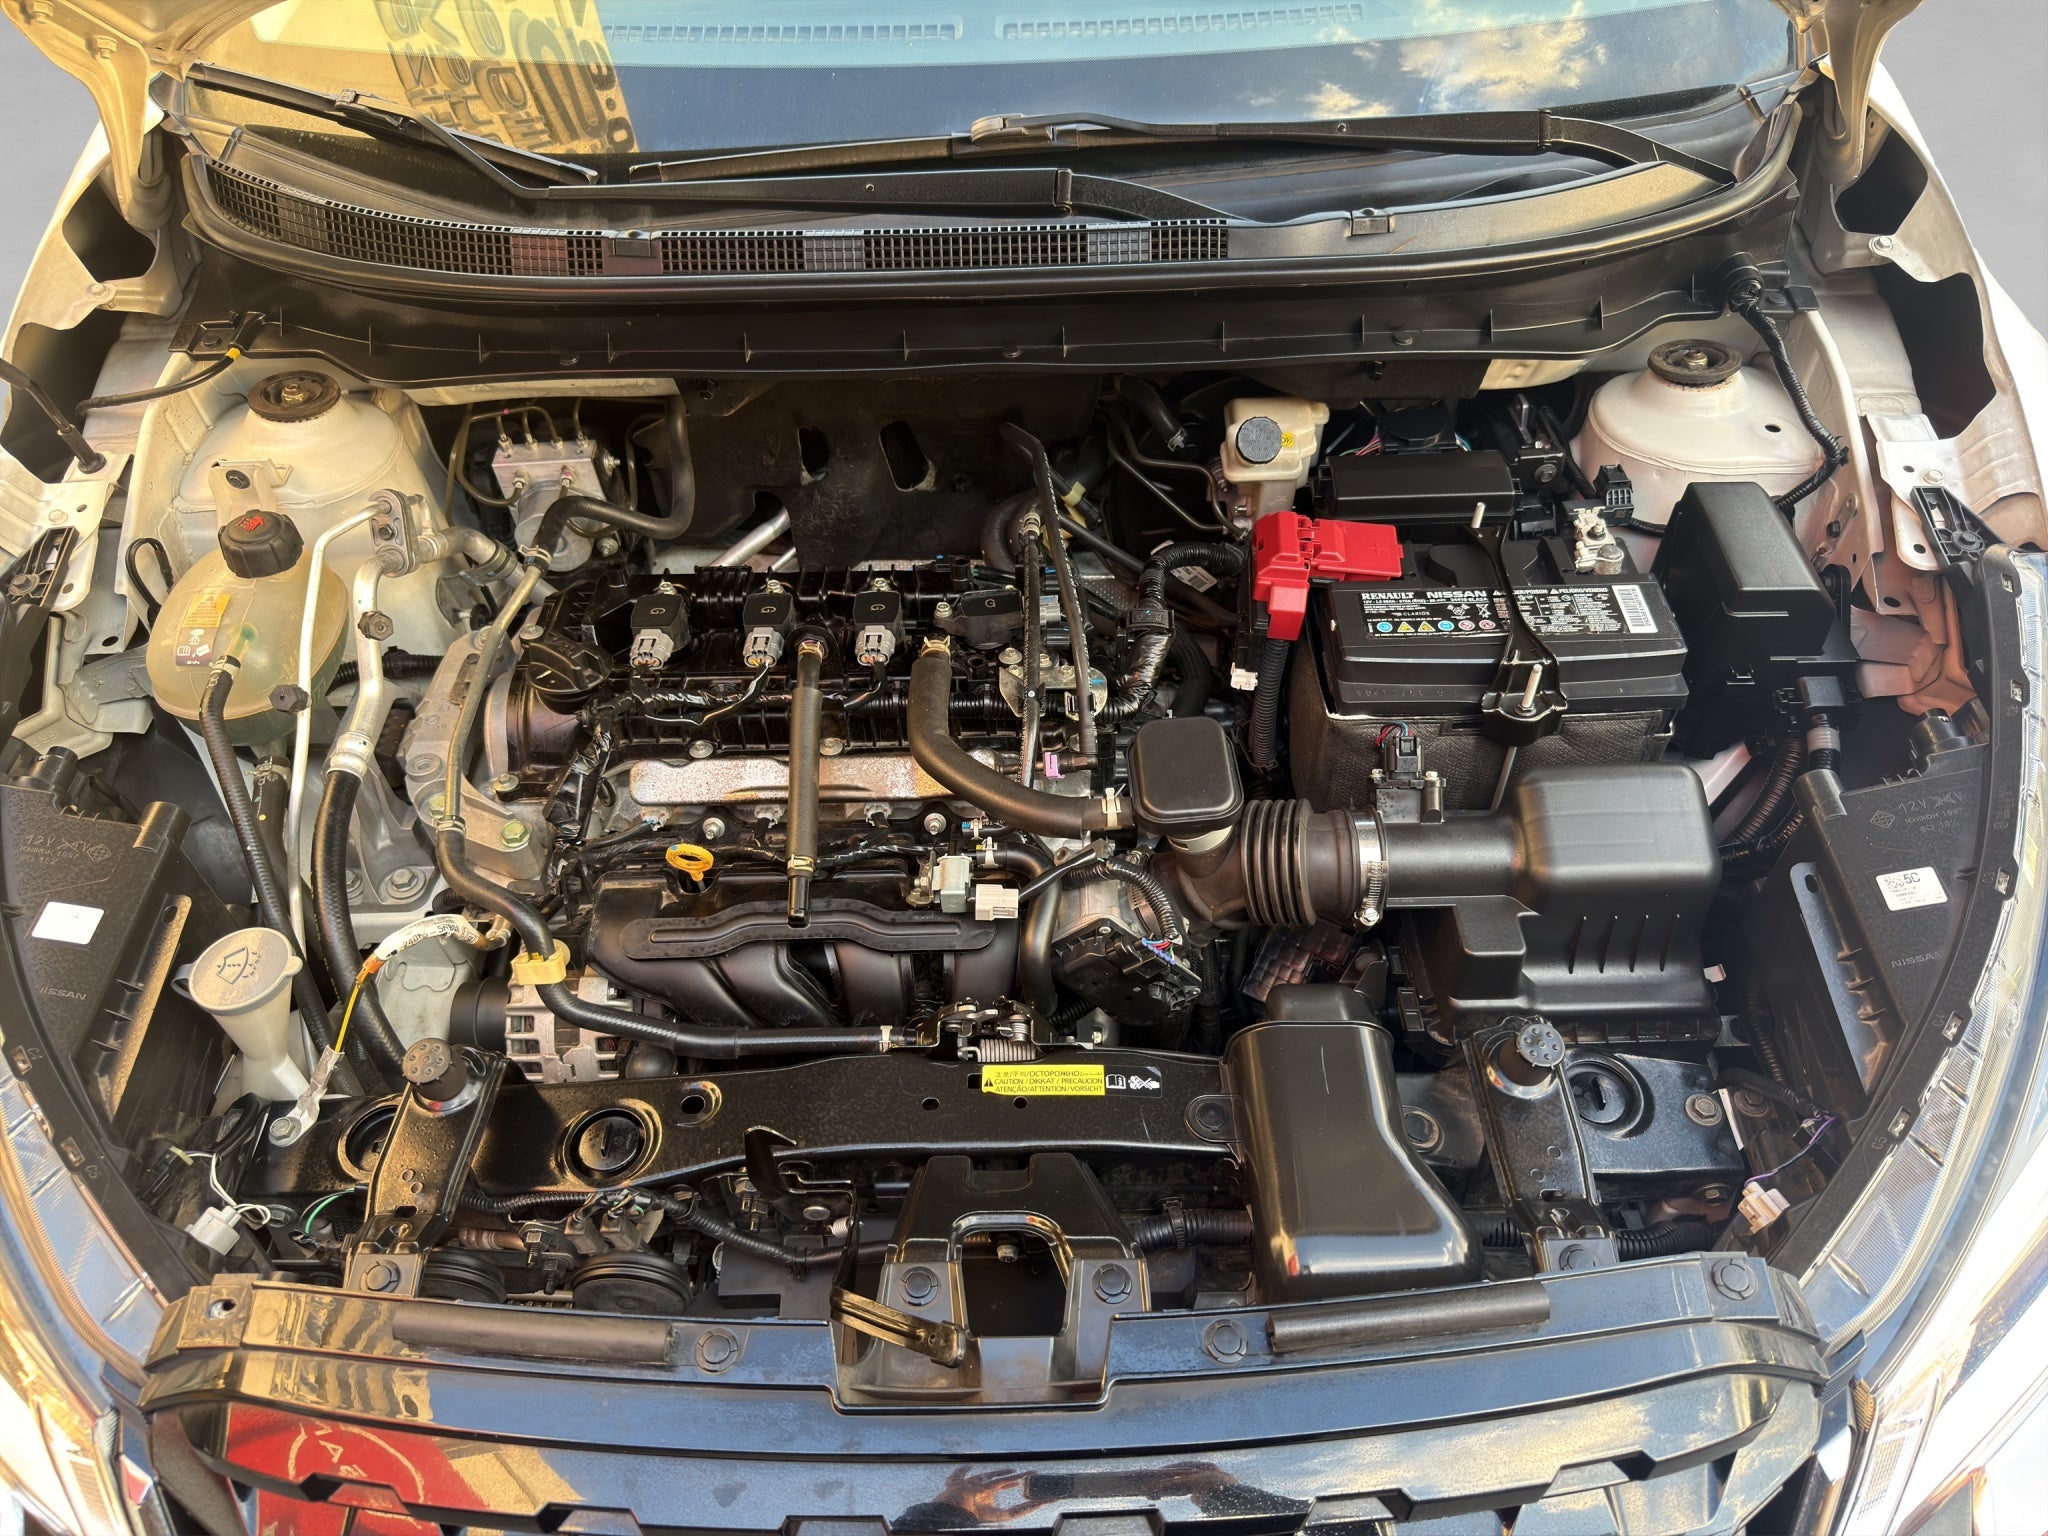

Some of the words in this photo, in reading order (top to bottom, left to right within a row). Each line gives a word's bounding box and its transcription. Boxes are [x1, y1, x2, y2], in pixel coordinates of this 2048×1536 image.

[1361, 592, 1415, 600] RENAULT
[1426, 590, 1487, 599] NISSAN
[1898, 798, 1927, 814] 12V
[26, 833, 56, 847] 12V
[1903, 872, 1921, 884] 5C
[1891, 951, 1946, 968] NISSAN
